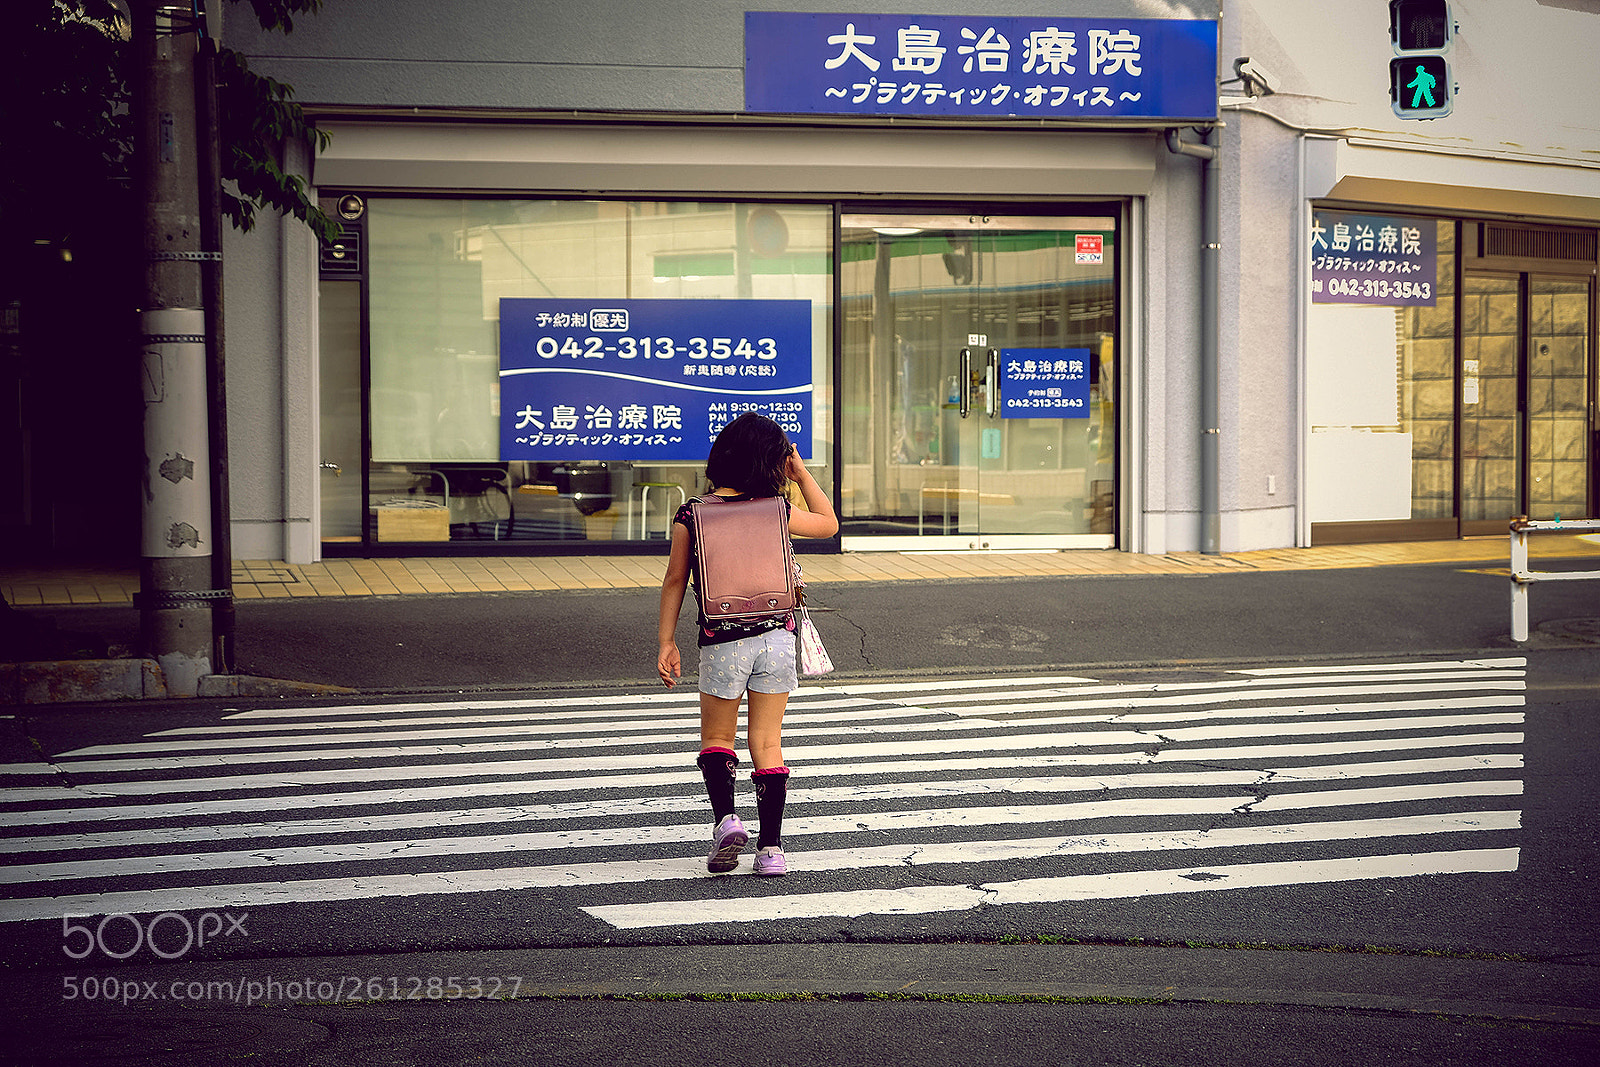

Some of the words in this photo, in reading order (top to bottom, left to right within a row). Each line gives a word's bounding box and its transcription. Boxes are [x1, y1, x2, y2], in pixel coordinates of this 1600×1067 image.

[824, 23, 1143, 77] 大島治療院
[1312, 219, 1421, 256] 大島治療院
[1328, 278, 1431, 300] 042-313-3543
[535, 312, 588, 328] 予約制
[536, 336, 778, 360] 042-313-3543
[1007, 359, 1084, 373] 大島治療院
[708, 402, 728, 412] AM
[730, 402, 803, 412] 9:30~12:30
[1007, 398, 1084, 408] 042-313-3543
[514, 403, 683, 431] 大島治療院
[708, 412, 728, 422] PM
